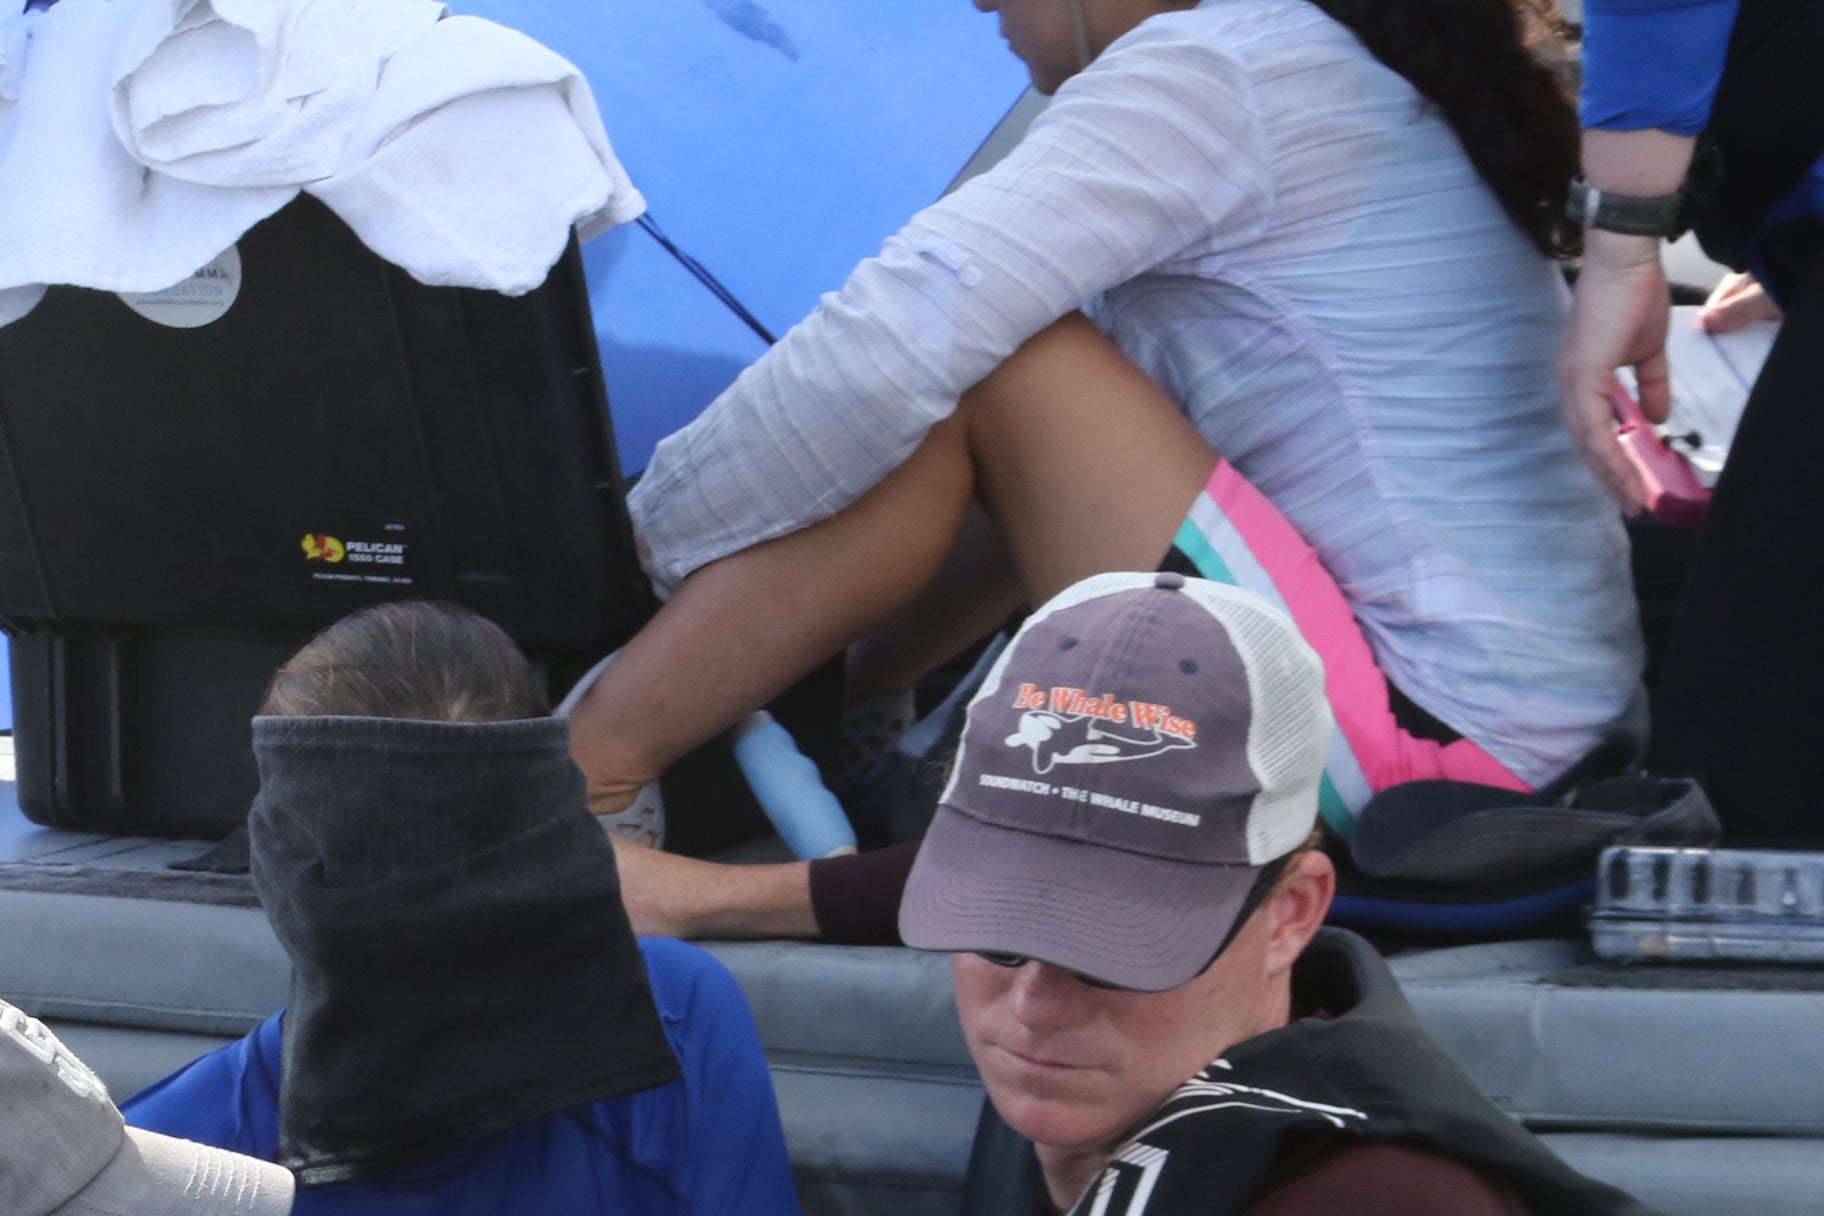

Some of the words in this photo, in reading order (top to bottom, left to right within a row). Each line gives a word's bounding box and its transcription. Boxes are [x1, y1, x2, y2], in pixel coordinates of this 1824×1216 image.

[346, 541, 404, 554] PELICAN
[375, 555, 404, 564] CASE
[1013, 683, 1048, 709] Be
[1049, 686, 1128, 723] Whale
[1129, 701, 1198, 739] Wise
[1061, 786, 1089, 802] THE
[1090, 791, 1140, 815] WHALE
[1140, 802, 1201, 828] MUSEUM
